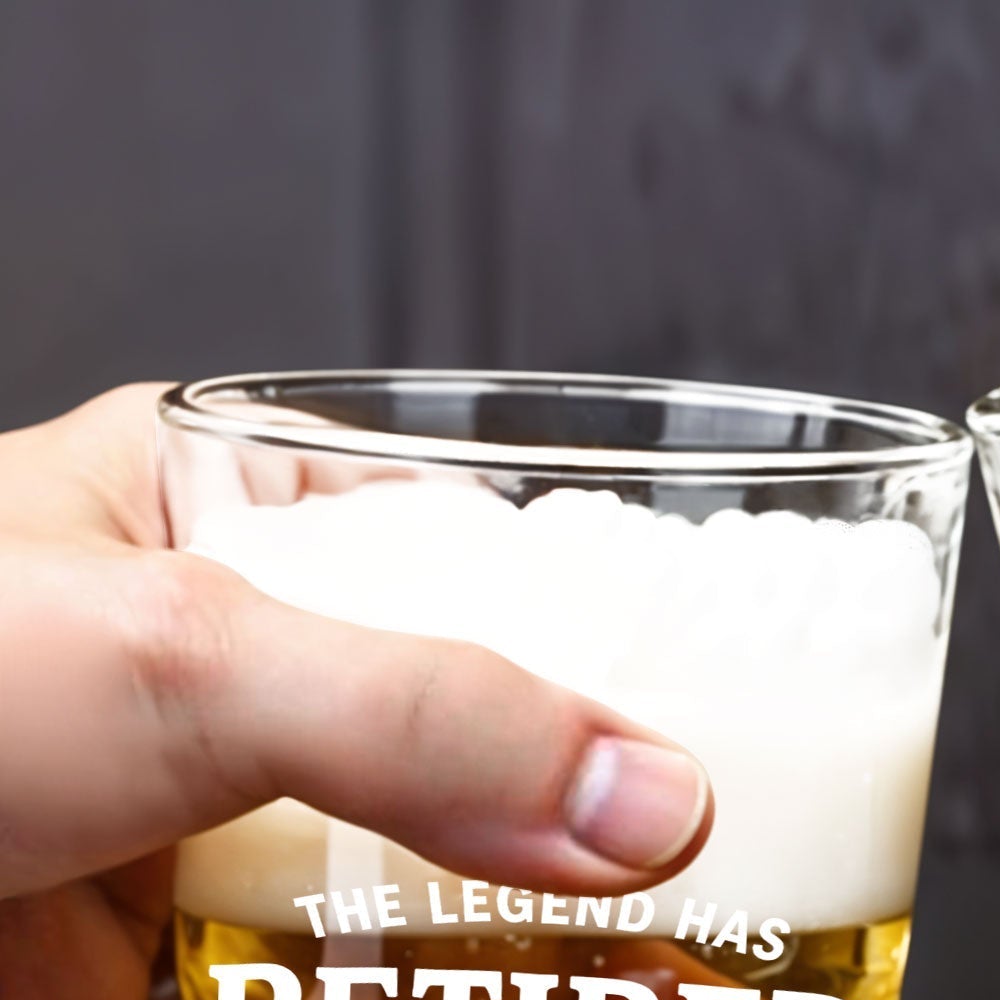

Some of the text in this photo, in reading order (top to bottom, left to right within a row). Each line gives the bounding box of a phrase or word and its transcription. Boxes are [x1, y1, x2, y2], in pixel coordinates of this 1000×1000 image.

[294, 880, 792, 961] THE LEGEND HAS
